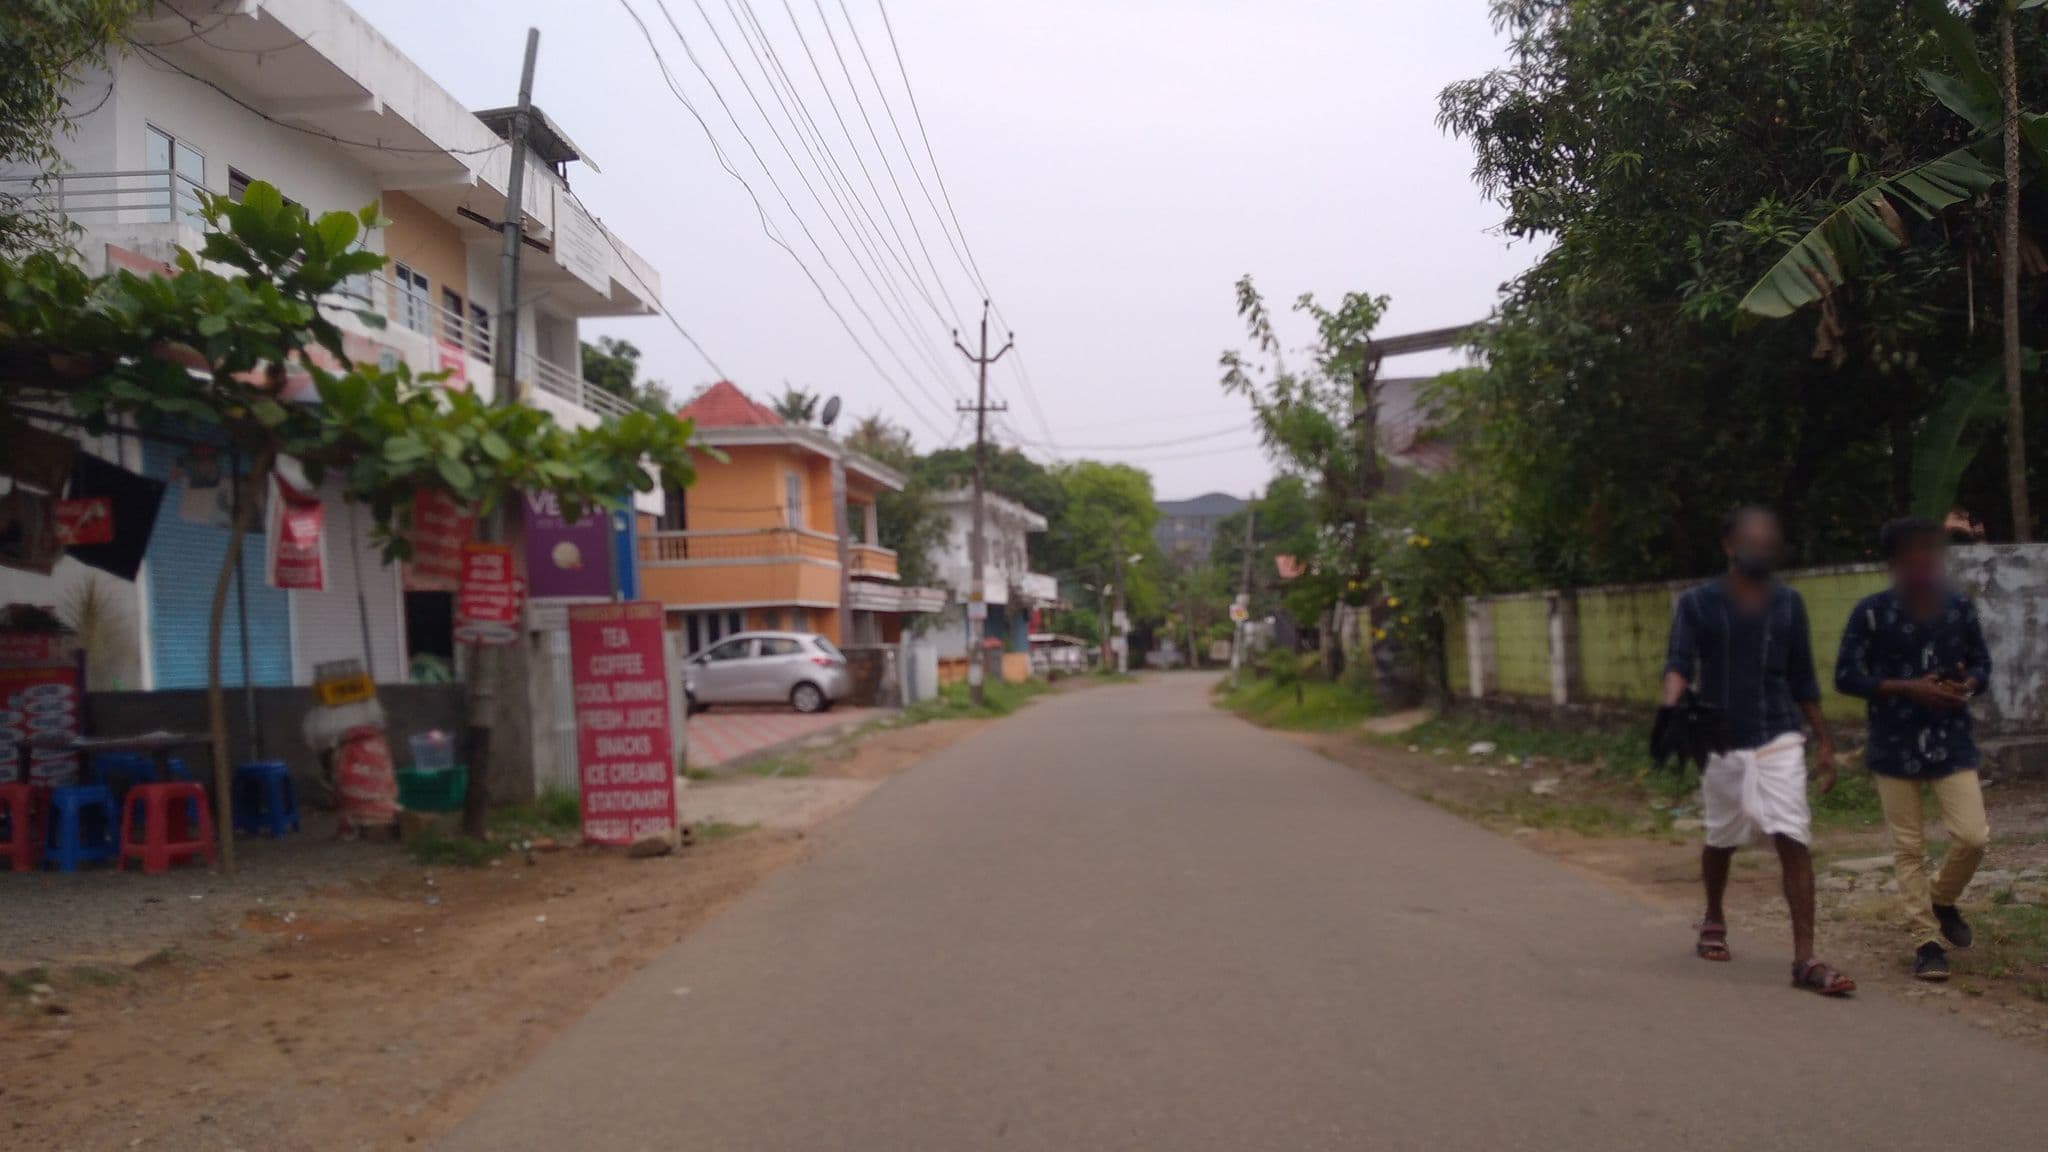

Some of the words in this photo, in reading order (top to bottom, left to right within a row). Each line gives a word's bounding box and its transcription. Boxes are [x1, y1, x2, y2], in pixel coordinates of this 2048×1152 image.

[601, 627, 631, 649] TEA
[590, 653, 644, 676] COFFEE
[576, 682, 612, 704] COOL
[613, 680, 664, 702] DRINKS
[579, 709, 624, 730] FRESH
[627, 707, 664, 729] JUICE
[595, 735, 652, 757] SNACKS
[583, 764, 608, 785] ICE
[608, 761, 666, 784] CREAMS
[587, 789, 669, 813] STATIONARY
